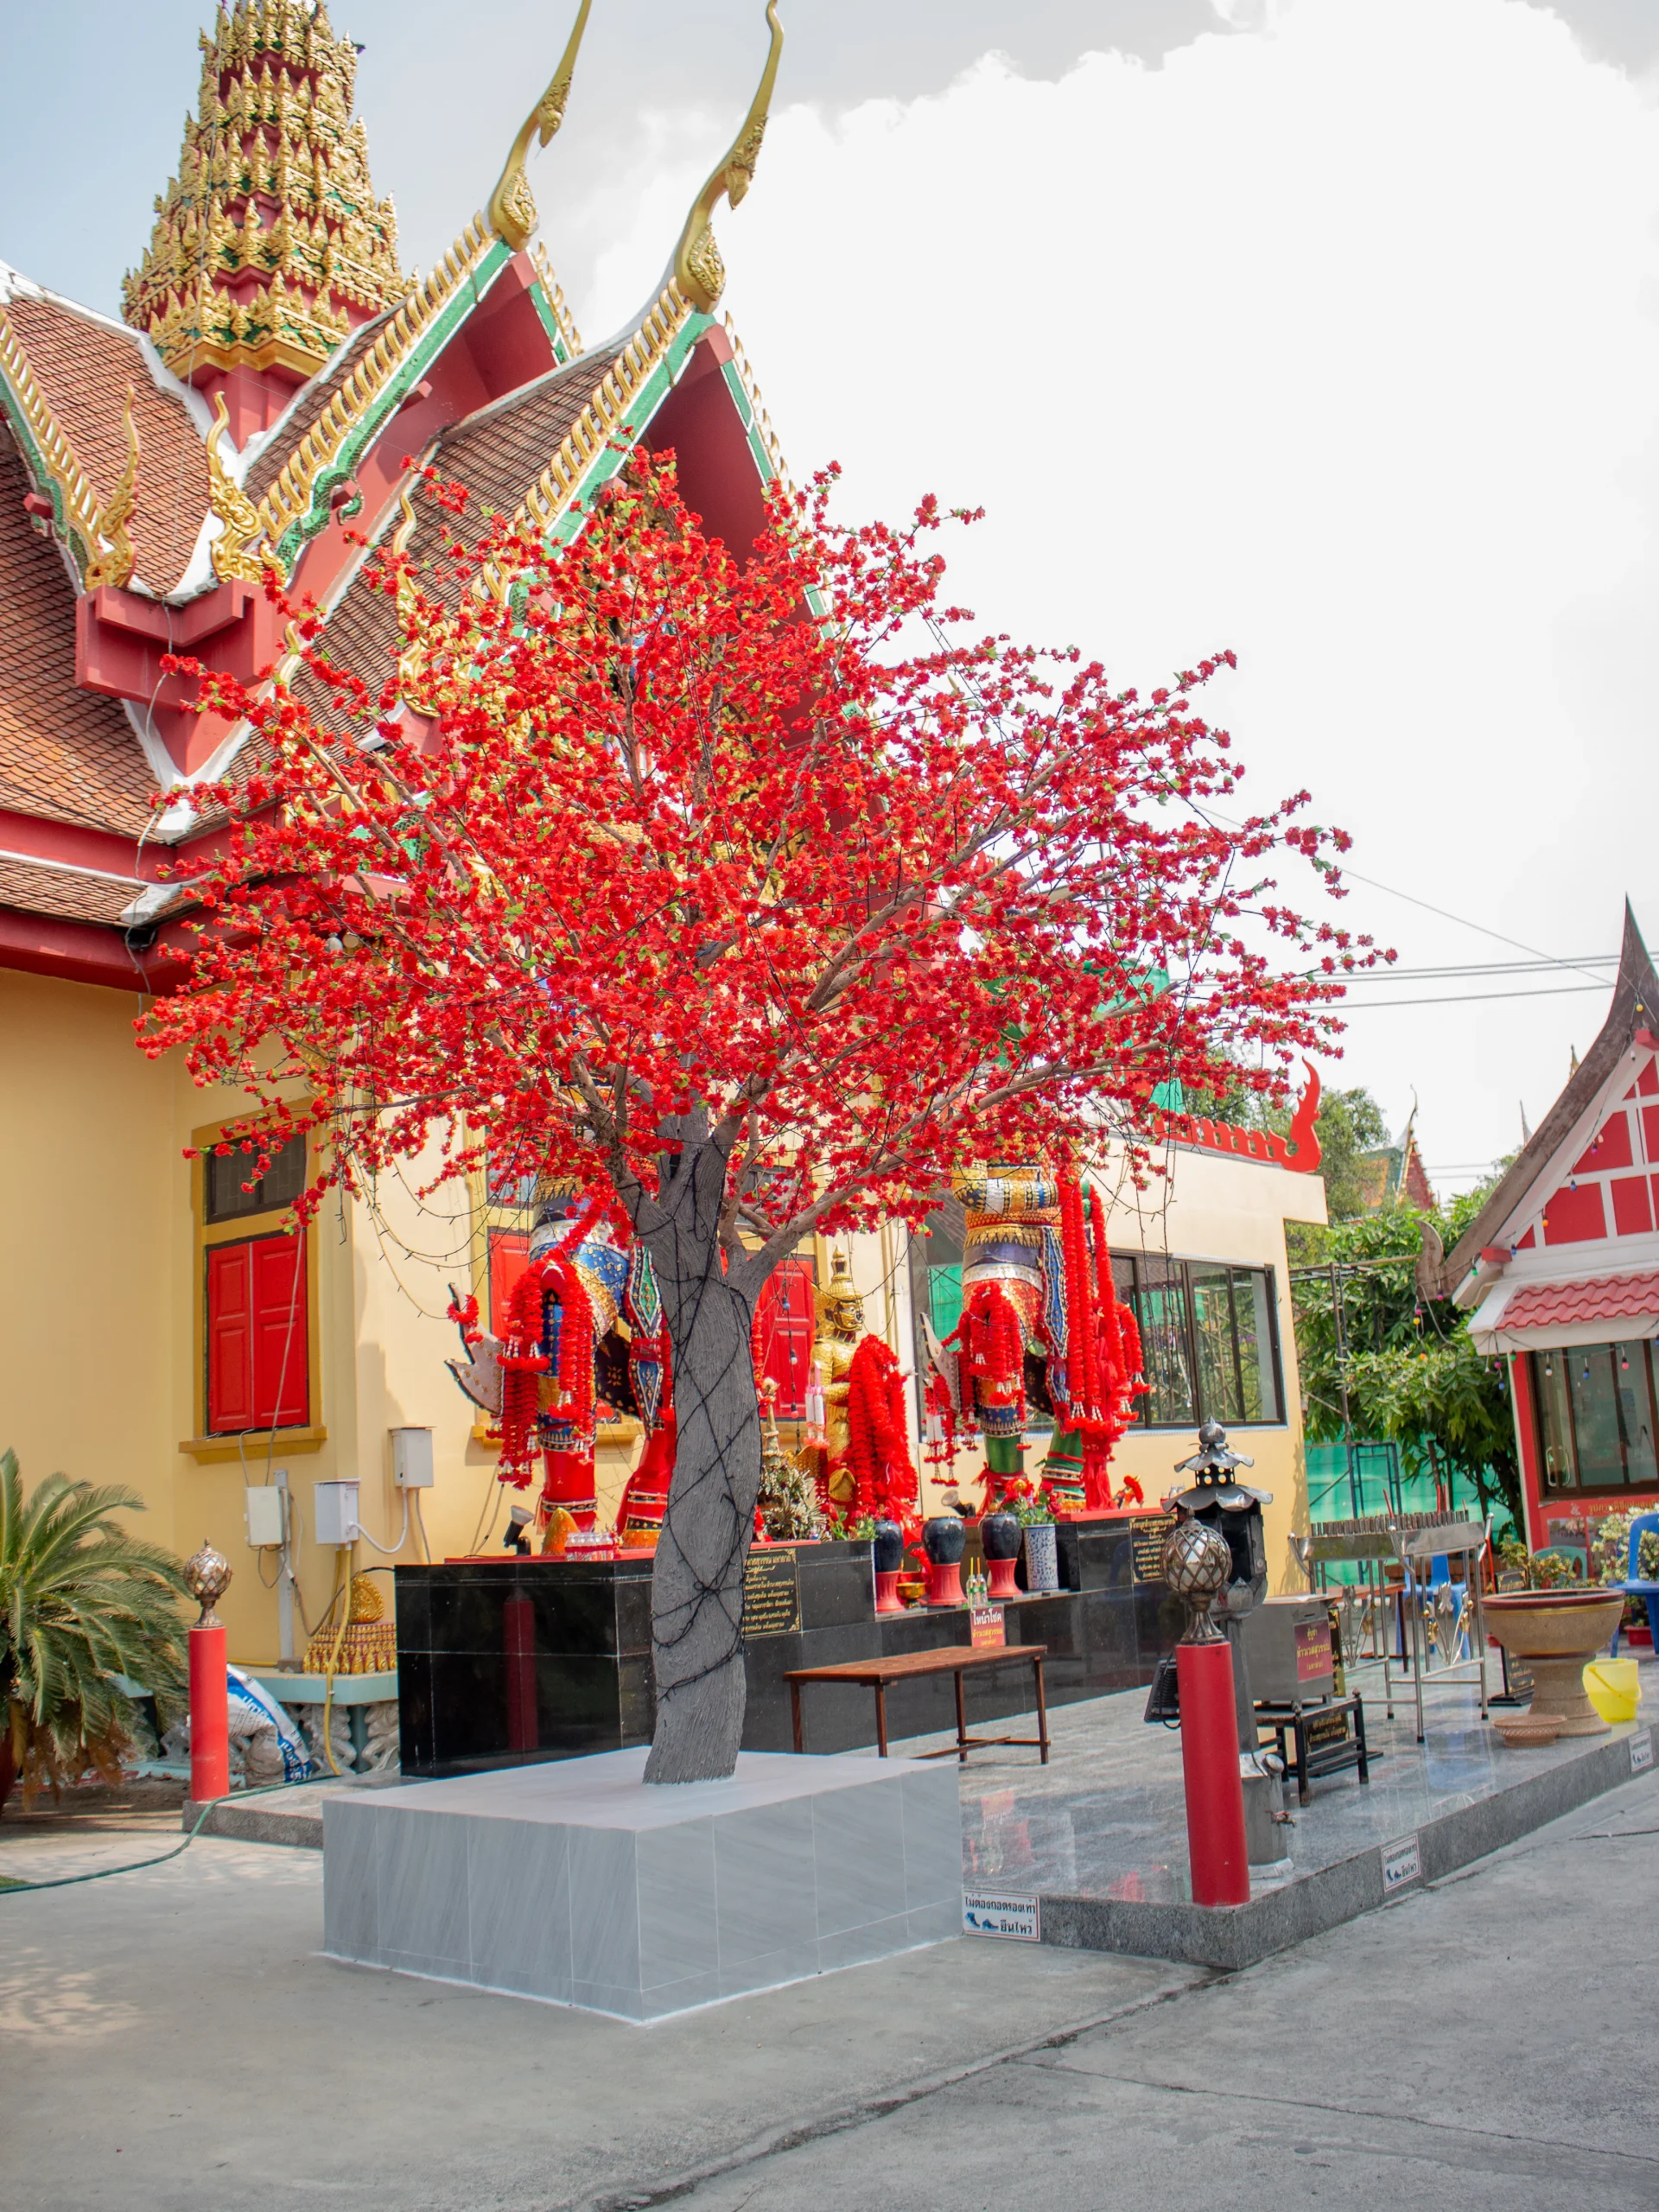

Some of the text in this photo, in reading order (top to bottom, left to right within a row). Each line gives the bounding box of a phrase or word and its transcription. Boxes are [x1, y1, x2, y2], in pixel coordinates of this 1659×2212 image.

[964, 1893, 1035, 1914] ไม่ต้องถอดรองเท้า
